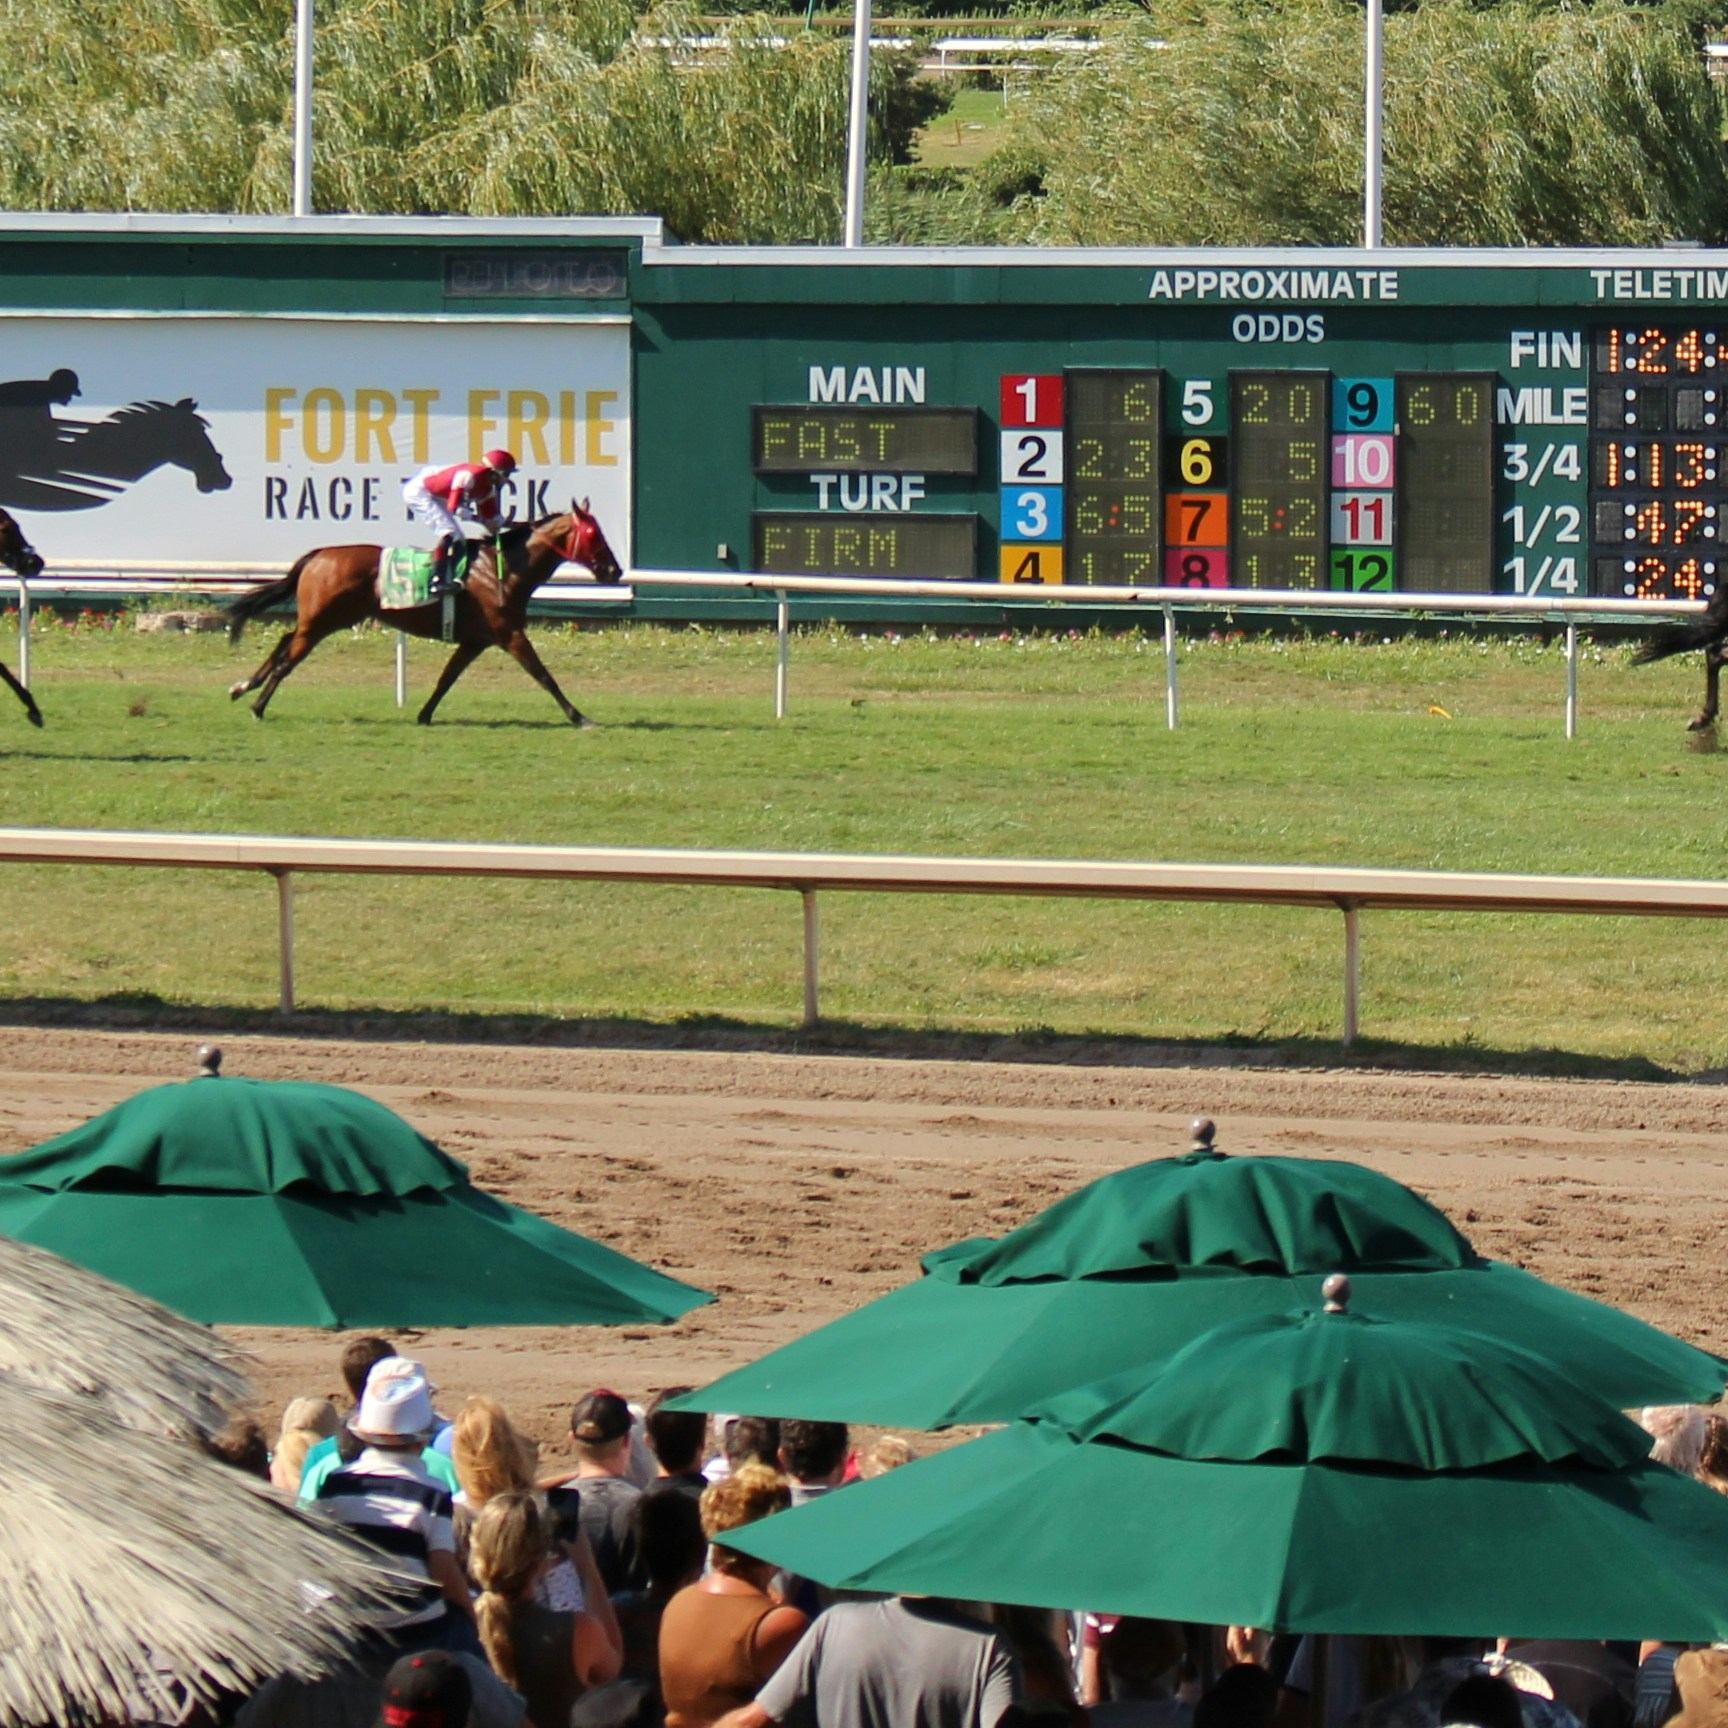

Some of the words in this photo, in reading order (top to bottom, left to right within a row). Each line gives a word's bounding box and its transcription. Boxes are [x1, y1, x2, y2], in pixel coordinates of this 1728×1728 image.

[1148, 270, 1399, 300] APPROXIMATE
[1231, 314, 1326, 344] ODDS
[1509, 332, 1582, 369] FIN
[808, 366, 926, 404] MAIN
[1015, 377, 1037, 423] 1
[1123, 383, 1152, 423] 6
[1181, 380, 1214, 425] 5
[1348, 383, 1378, 428] 9
[264, 387, 440, 465] FORT
[467, 389, 619, 467] ERIE
[1497, 388, 1587, 425] MILE
[763, 421, 897, 461] FAST
[1016, 436, 1048, 479] 2
[1181, 439, 1212, 484] 6
[1288, 441, 1317, 481] 5
[1336, 438, 1389, 484] 10
[1503, 443, 1582, 485] 3/4
[264, 475, 382, 521] RACE
[809, 474, 927, 511] TURF
[1016, 491, 1049, 538] 3
[1076, 495, 1152, 536] 6:5
[1181, 500, 1213, 543] 7
[1241, 497, 1317, 538] 5:2
[1339, 496, 1386, 543] 11
[1503, 505, 1581, 549] 1/2
[763, 528, 897, 568] FIRM
[1012, 550, 1047, 583] 4
[387, 561, 414, 600] 5
[1180, 553, 1211, 587] 8
[1334, 552, 1389, 590] 12
[1503, 556, 1580, 597] 1/4
